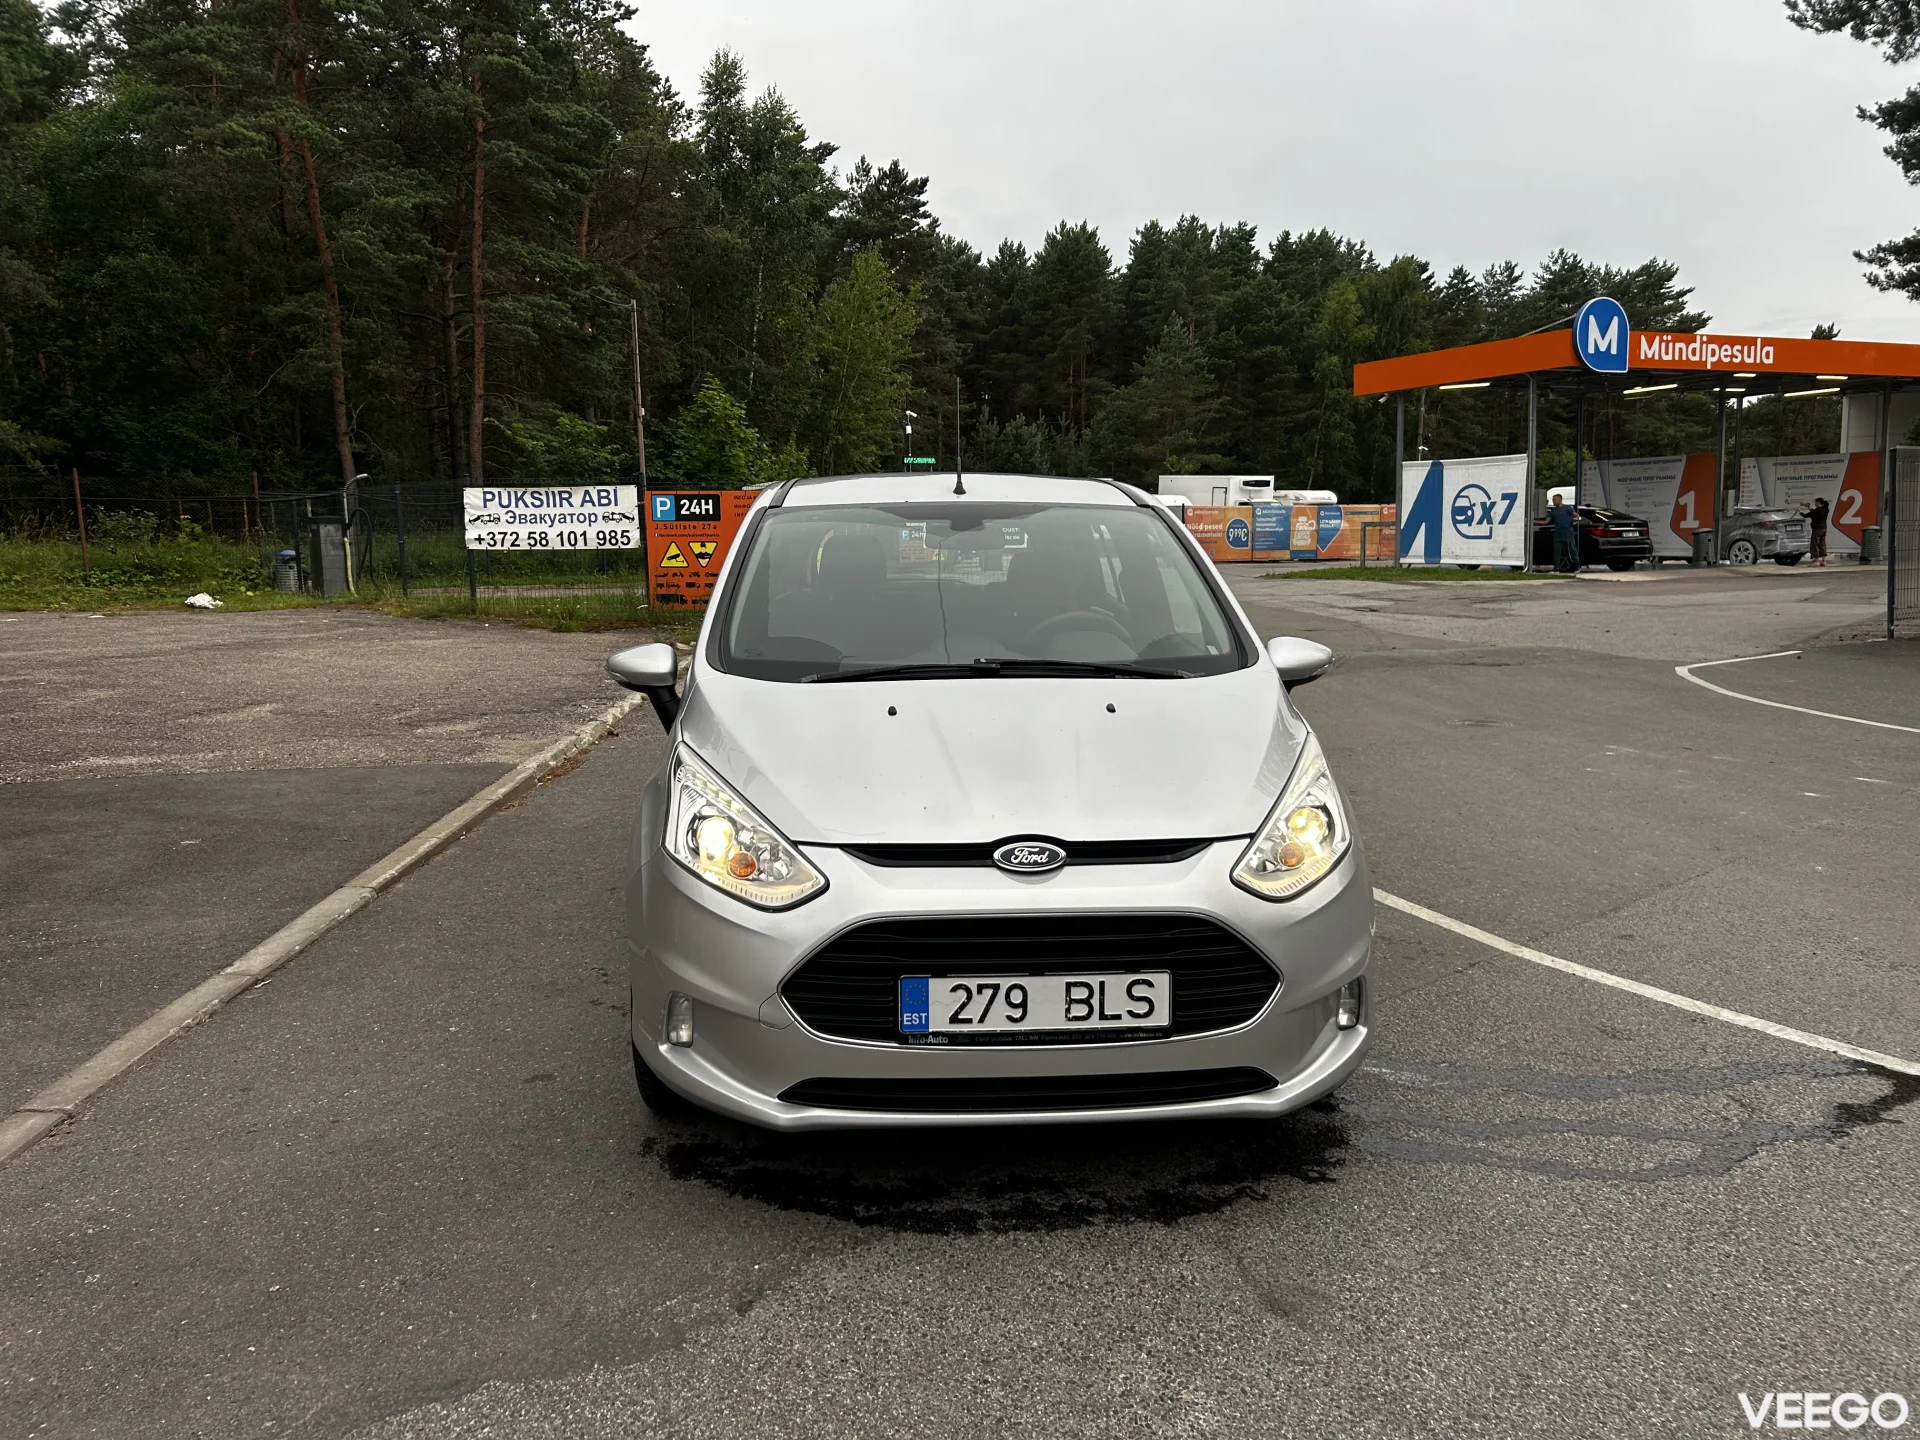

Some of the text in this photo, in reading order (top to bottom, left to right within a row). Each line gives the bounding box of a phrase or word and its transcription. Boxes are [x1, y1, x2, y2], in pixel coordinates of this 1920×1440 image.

[1588, 315, 1618, 355] M
[1641, 335, 1774, 369] Mündipesula
[482, 489, 618, 509] PUKSIIR ABI
[656, 497, 714, 518] P 24H
[1678, 490, 1699, 528] 1
[1840, 489, 1863, 524] 2
[505, 509, 598, 528] Эвакуатор
[1204, 523, 1223, 531] pesed
[474, 530, 631, 548] +372 58 101 985
[1011, 847, 1048, 864] Ford
[949, 978, 1155, 1024] 279 BLS
[903, 1013, 928, 1025] EST
[908, 1035, 949, 1044] Info-Auto
